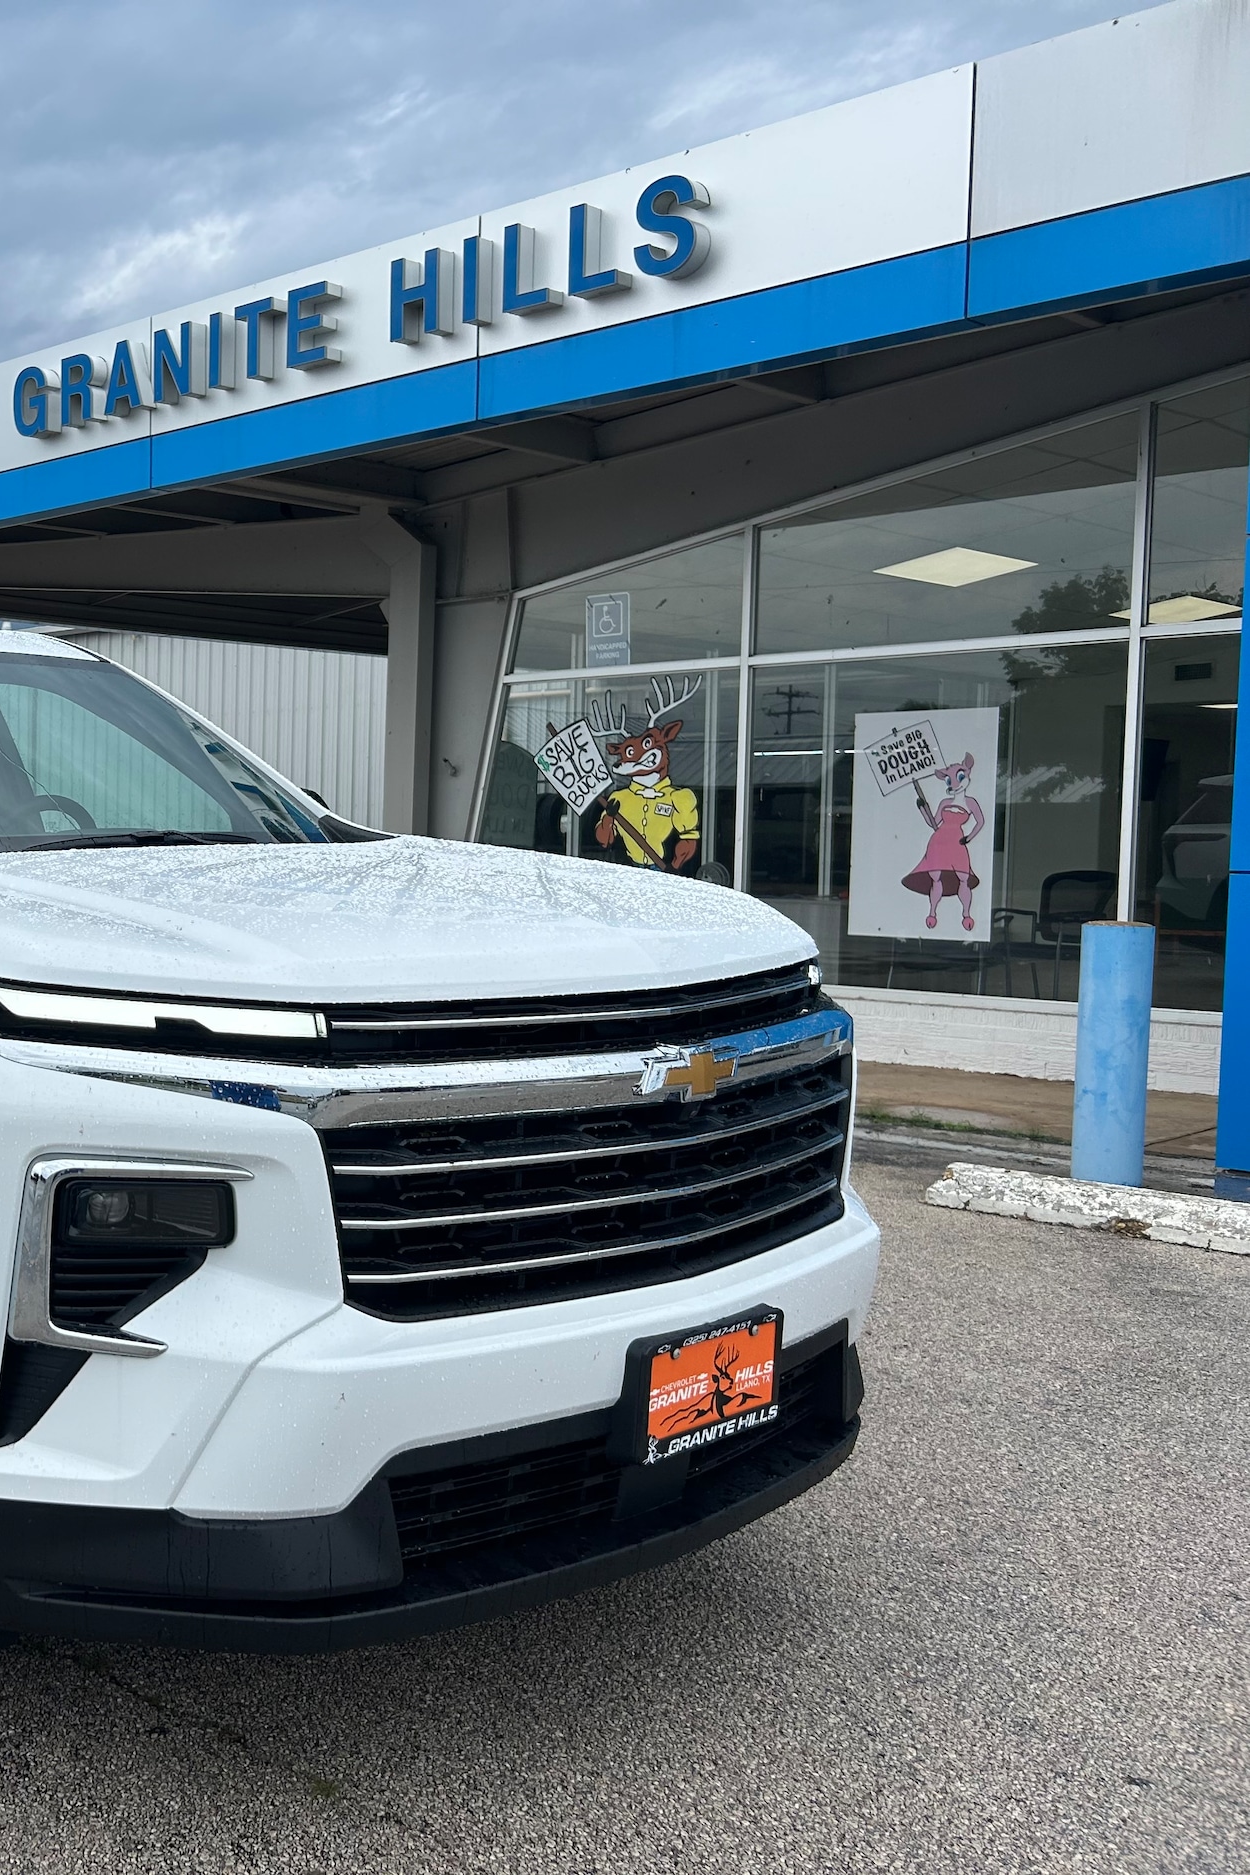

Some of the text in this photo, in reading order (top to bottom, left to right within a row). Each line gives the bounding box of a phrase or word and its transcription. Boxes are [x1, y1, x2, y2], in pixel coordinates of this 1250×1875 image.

[13, 175, 711, 438] GRANITE HILLS
[589, 642, 627, 651] HANDICAPPED
[595, 651, 620, 660] PARKING
[905, 729, 922, 744] BIG
[553, 748, 595, 789] BIG
[877, 739, 931, 775] DOUGH
[897, 754, 936, 779] LLANO!
[567, 764, 609, 807] BUCKS
[683, 1320, 752, 1347] (325) 247-4151
[660, 1376, 697, 1392] CHEVROLET
[735, 1360, 774, 1383] HILLS
[735, 1374, 771, 1392] LLANO, TX
[649, 1380, 709, 1412] GRANITE
[668, 1405, 779, 1455] GRANITE HILLS
